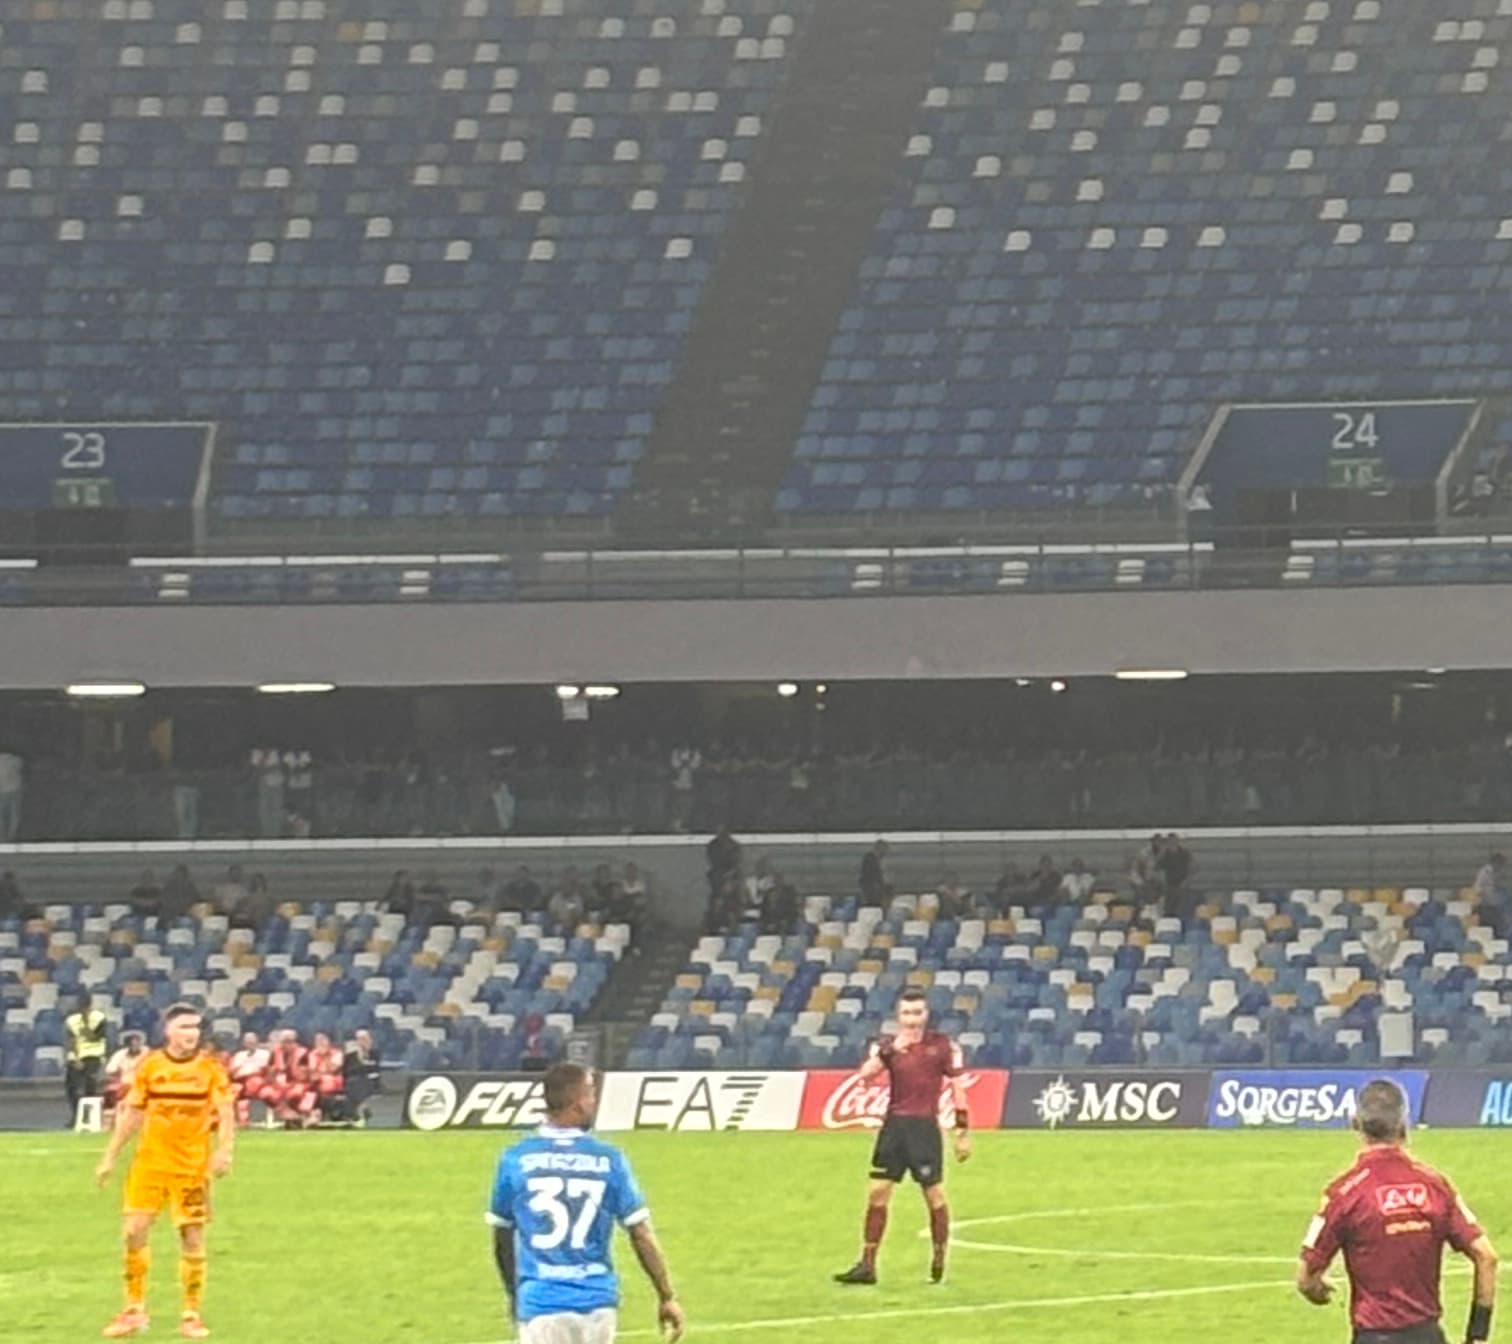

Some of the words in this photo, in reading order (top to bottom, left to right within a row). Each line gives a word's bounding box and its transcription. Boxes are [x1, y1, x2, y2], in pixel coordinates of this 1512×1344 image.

[60, 431, 106, 469] 23
[1331, 412, 1379, 449] 24
[634, 1076, 770, 1130] EA7
[1077, 1082, 1182, 1121] MSC
[527, 1176, 607, 1250] 37
